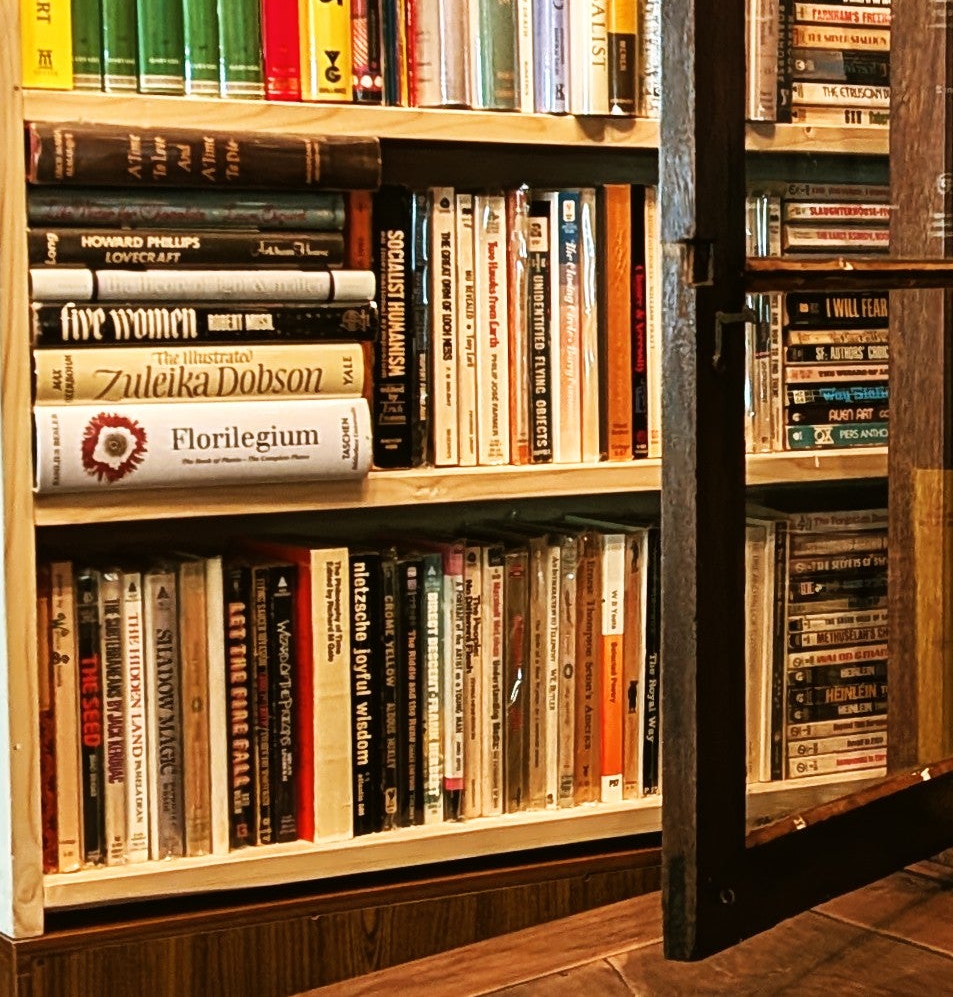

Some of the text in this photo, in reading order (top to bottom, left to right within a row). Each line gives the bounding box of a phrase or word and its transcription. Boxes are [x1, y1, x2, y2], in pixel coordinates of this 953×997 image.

[822, 87, 838, 98] THE
[82, 236, 200, 249] HOWARD PHILLIPS
[106, 252, 181, 264] LOVECRAFT
[60, 302, 196, 341] five women
[388, 231, 406, 376] SOCIALIST HUMANISM
[834, 298, 858, 318] WILL
[861, 298, 887, 316] FEAR
[153, 351, 253, 366] The Illustrated
[343, 356, 353, 385] YALE
[535, 356, 546, 394] FLYING
[92, 364, 323, 400] Zuleika Dobson
[171, 426, 319, 453] Florilegium
[342, 417, 350, 460] TASCHEN
[536, 400, 547, 447] OBJECTS
[861, 429, 888, 437] ANTHO
[385, 595, 396, 687] CROME YELLOW
[156, 629, 174, 710] SHADOW
[353, 562, 372, 765] nietzsche joyful wisdom
[81, 654, 101, 747] THE SEED
[229, 603, 250, 788] LET THE FALL
[647, 680, 656, 712] Royal
[826, 685, 876, 702] HEINLEIN
[132, 714, 142, 758] LAND
[646, 716, 656, 742] Way
